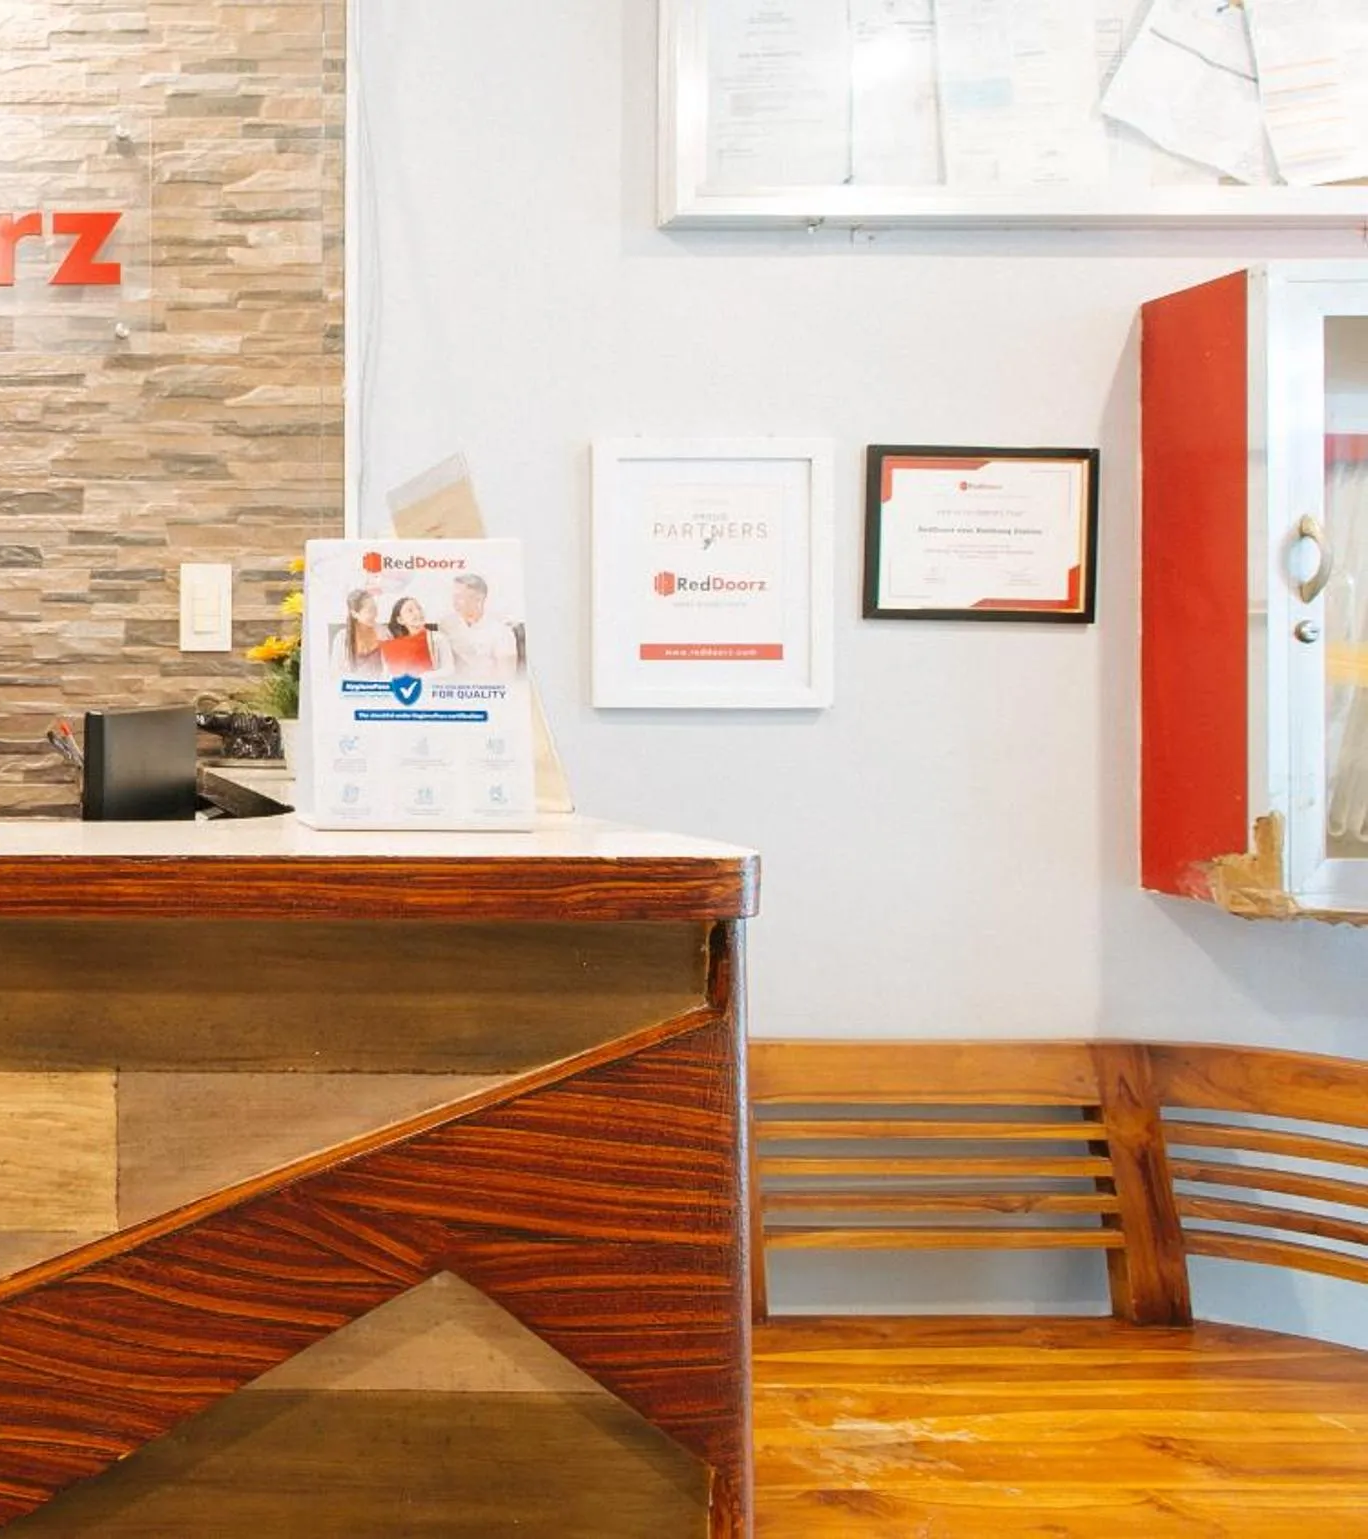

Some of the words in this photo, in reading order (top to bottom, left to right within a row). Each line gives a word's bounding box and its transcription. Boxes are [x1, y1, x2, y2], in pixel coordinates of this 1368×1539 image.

[653, 521, 769, 540] PARTNERS
[383, 555, 467, 570] RedDoorz
[677, 575, 768, 592] RedDoorz
[432, 690, 454, 699] FOR
[458, 690, 507, 700] QUALITY
